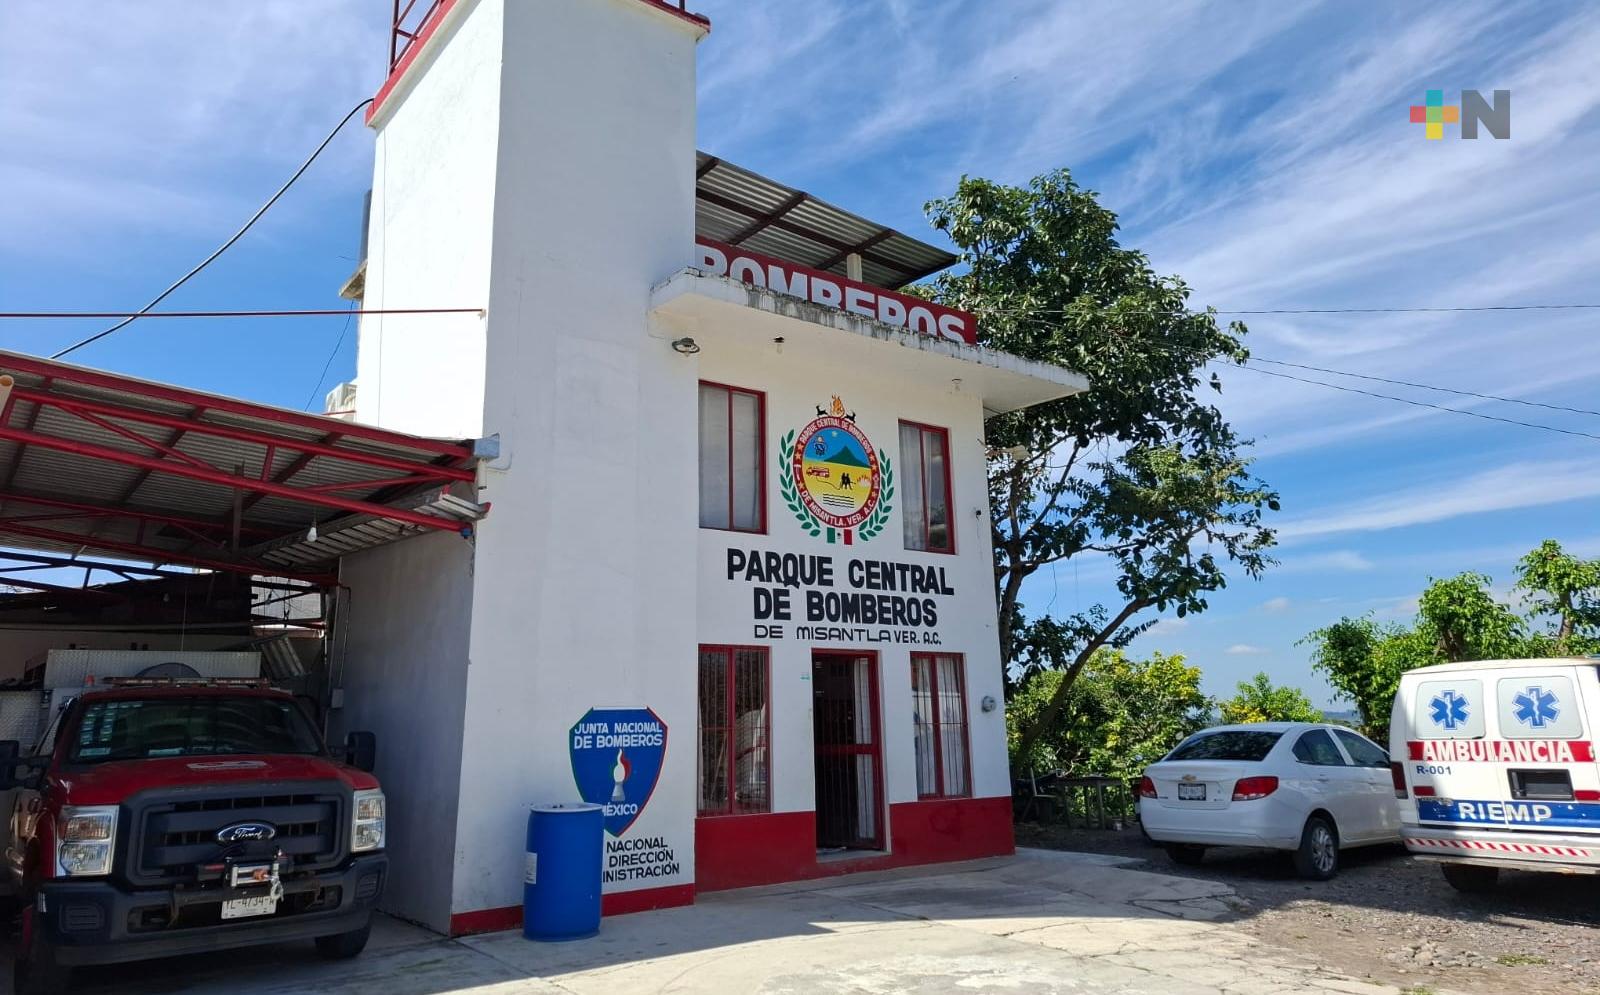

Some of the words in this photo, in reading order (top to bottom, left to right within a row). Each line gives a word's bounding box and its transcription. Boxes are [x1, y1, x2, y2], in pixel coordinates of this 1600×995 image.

[800, 421, 817, 444] PARQUE
[816, 417, 840, 428] CENTRAL
[841, 420, 849, 430] DE
[848, 424, 873, 454] BOMBEROS
[801, 490, 811, 503] DE
[727, 548, 834, 589] PARQUE
[848, 559, 955, 596] CENTRAL
[753, 587, 791, 621] DE
[806, 590, 938, 627] BOMBEROS
[754, 624, 784, 639] DE
[922, 631, 942, 645] A.C.
[574, 722, 609, 735] JUNTA
[614, 721, 663, 735] NACIONAL
[573, 735, 593, 749] DE
[596, 734, 664, 749] BOMBEROS
[1423, 740, 1576, 762] AMBULANCIA
[1416, 765, 1452, 775] R-001
[1458, 802, 1552, 822] RIEMP
[231, 827, 263, 840] Ford
[606, 837, 669, 854] NACIONAL
[608, 849, 674, 868] DIRECCIÓN
